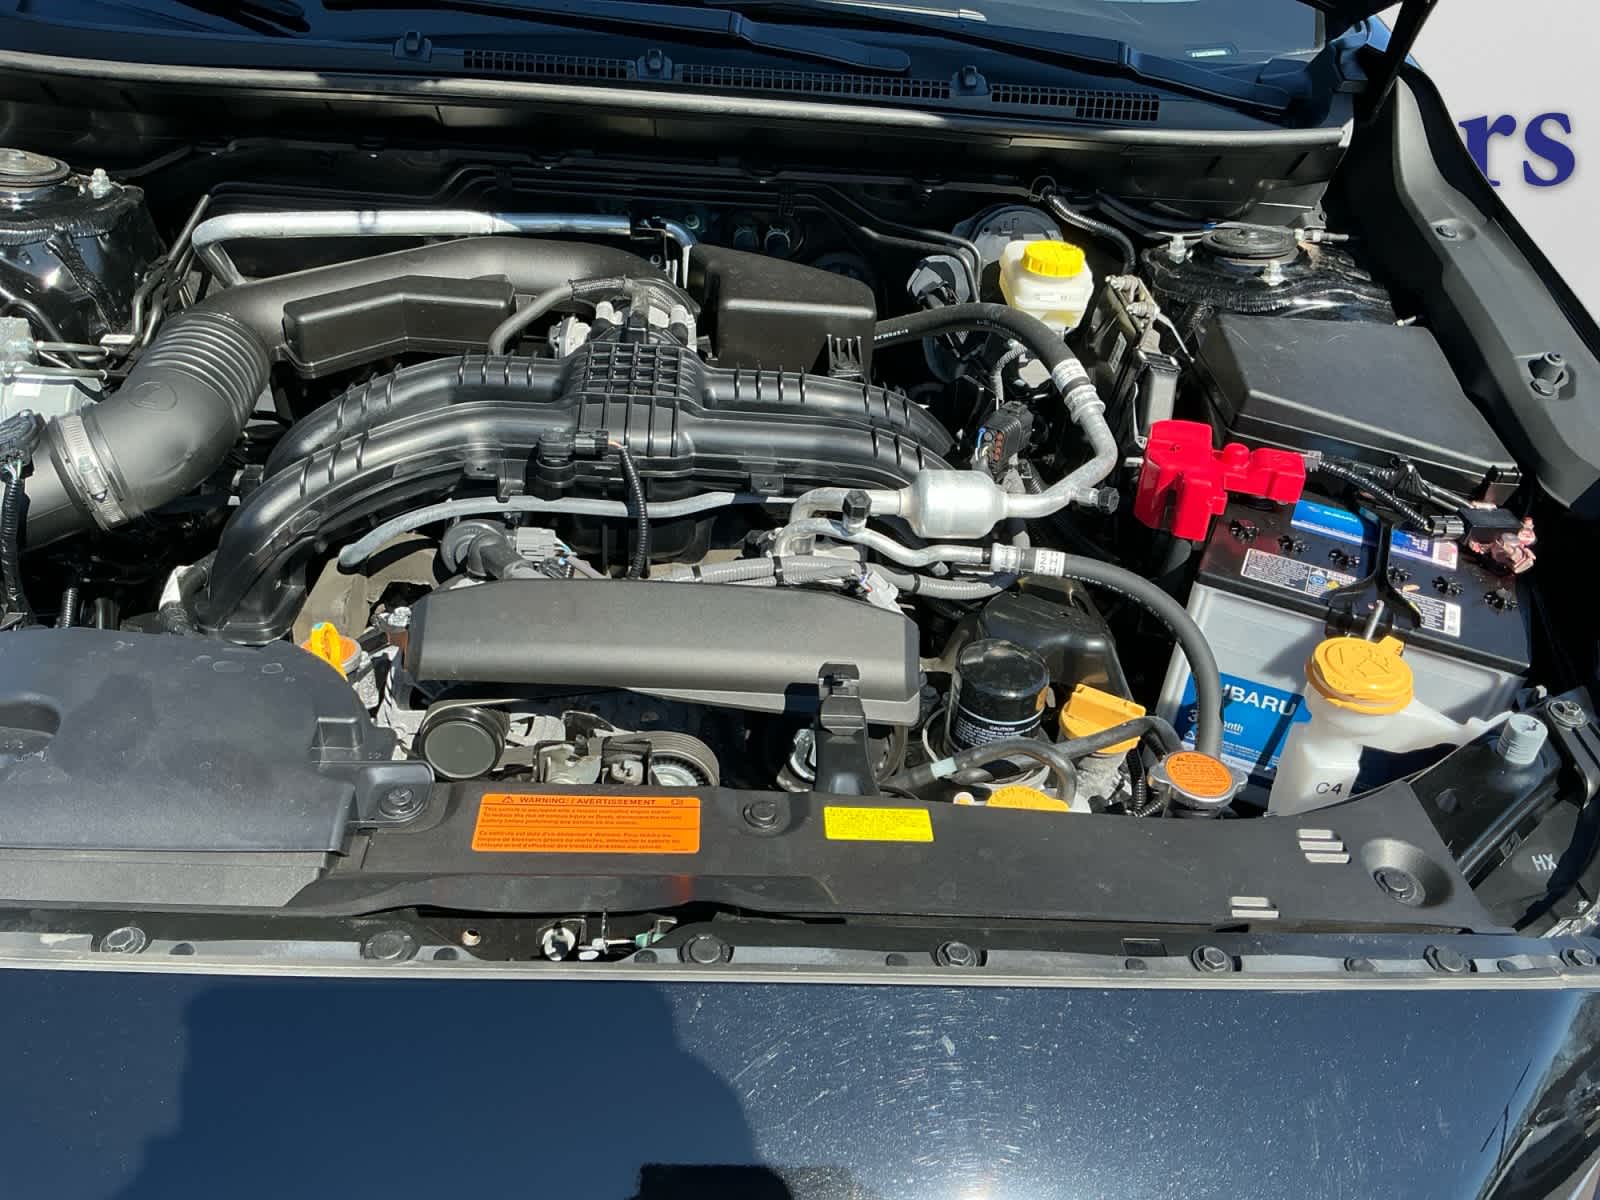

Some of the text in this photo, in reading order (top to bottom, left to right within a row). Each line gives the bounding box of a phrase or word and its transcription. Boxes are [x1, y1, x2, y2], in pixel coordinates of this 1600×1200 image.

[1222, 683, 1297, 716] BARU
[1315, 782, 1343, 796] C4
[1531, 853, 1557, 872] HX
